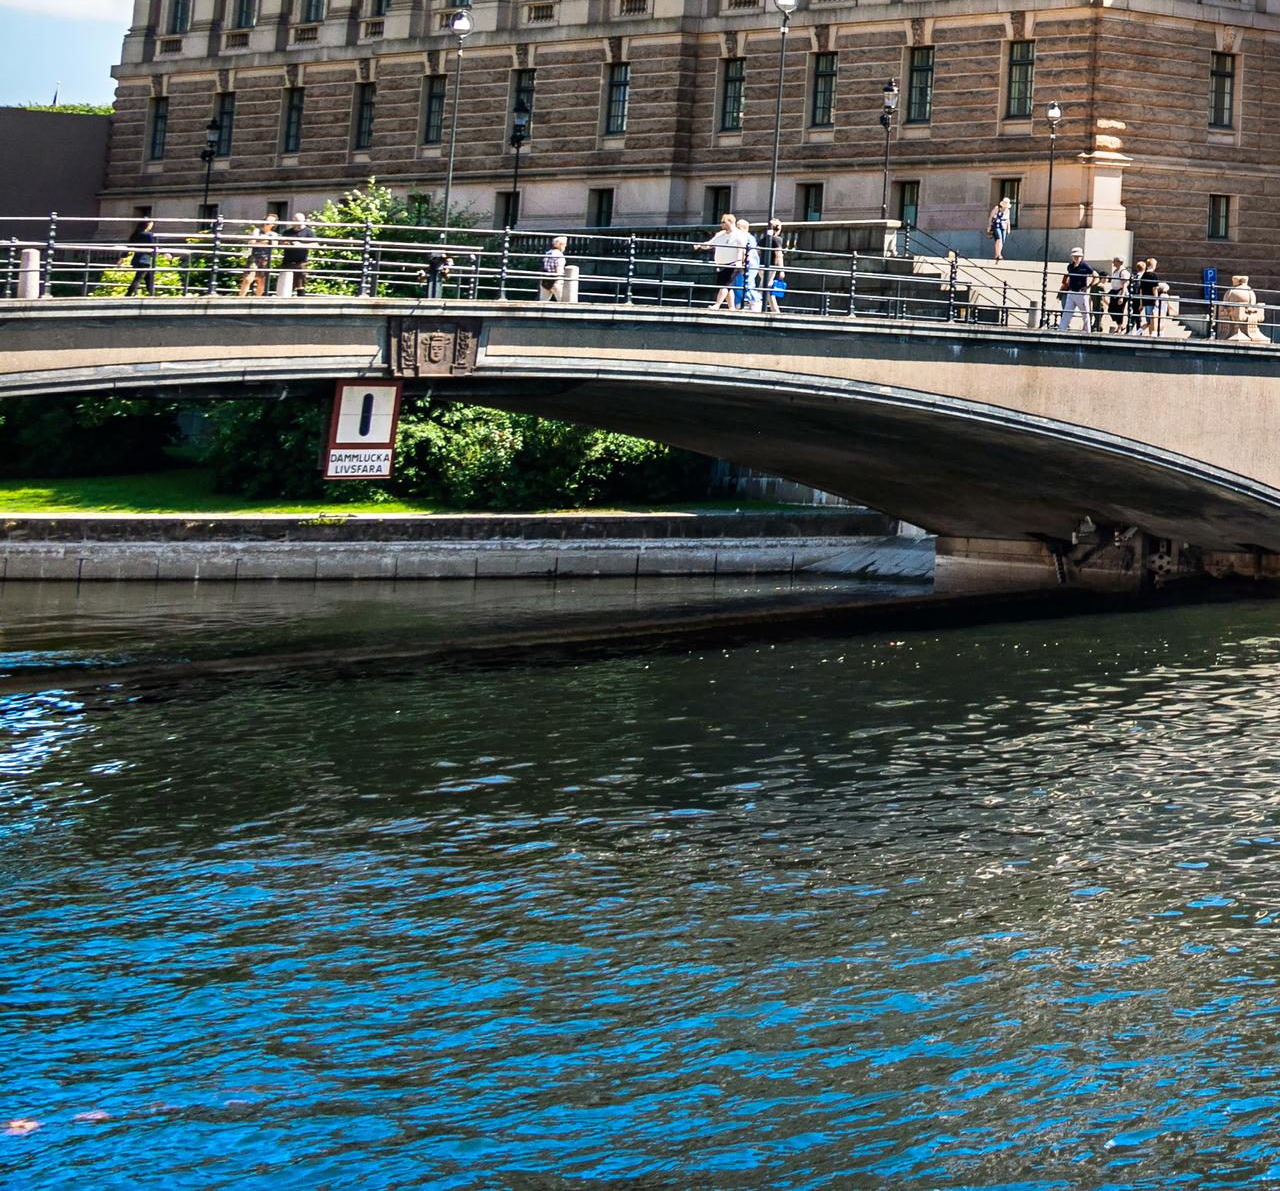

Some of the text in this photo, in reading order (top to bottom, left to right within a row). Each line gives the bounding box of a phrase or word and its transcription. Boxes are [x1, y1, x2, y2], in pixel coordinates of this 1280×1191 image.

[1207, 270, 1214, 281] P
[330, 453, 390, 463] DAMMLUCKA
[334, 464, 383, 474] LIVSFARA
